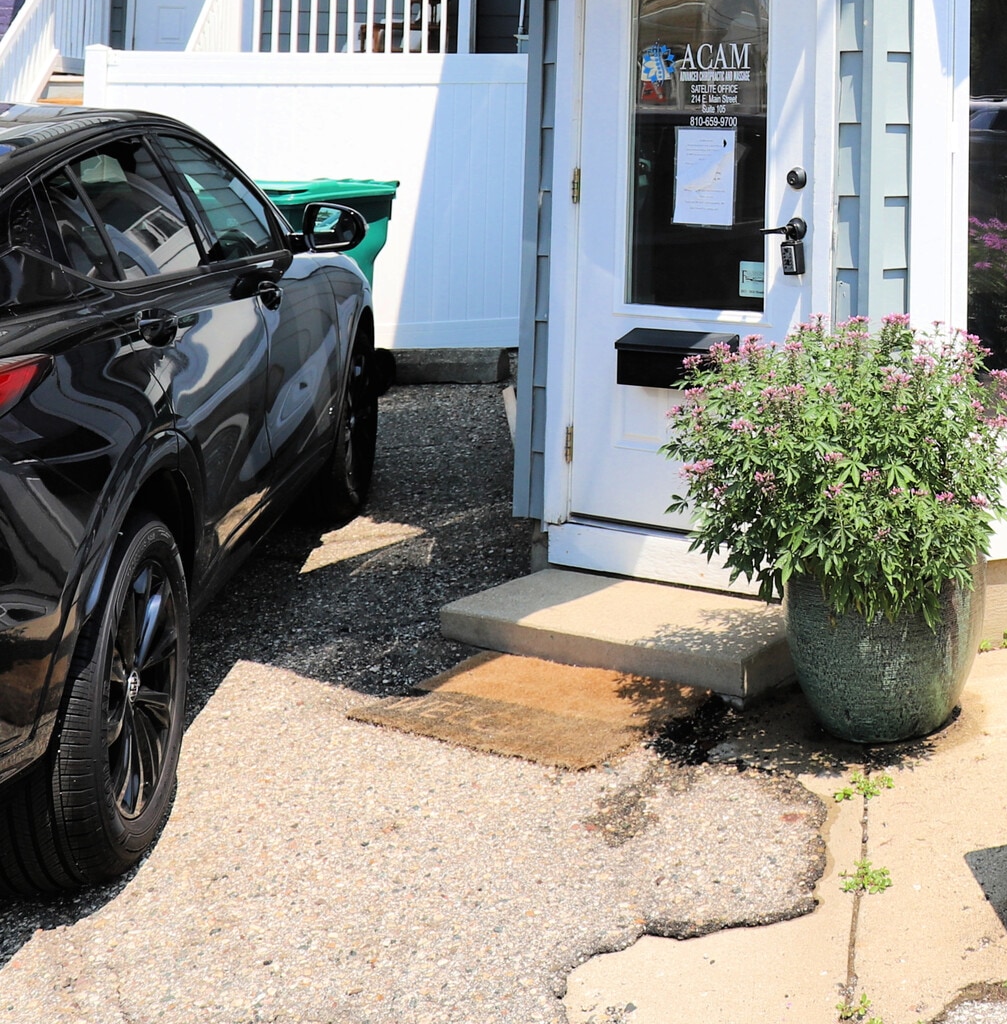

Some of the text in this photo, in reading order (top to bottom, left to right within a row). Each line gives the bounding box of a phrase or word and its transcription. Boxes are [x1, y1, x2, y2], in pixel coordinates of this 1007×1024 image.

[680, 43, 751, 70] ACAM
[717, 84, 739, 94] OFFICE
[691, 95, 701, 104] 214
[708, 95, 722, 104] Main
[722, 95, 738, 104] Street
[702, 105, 726, 114] Suite 105
[690, 117, 738, 127] 810-659-9700
